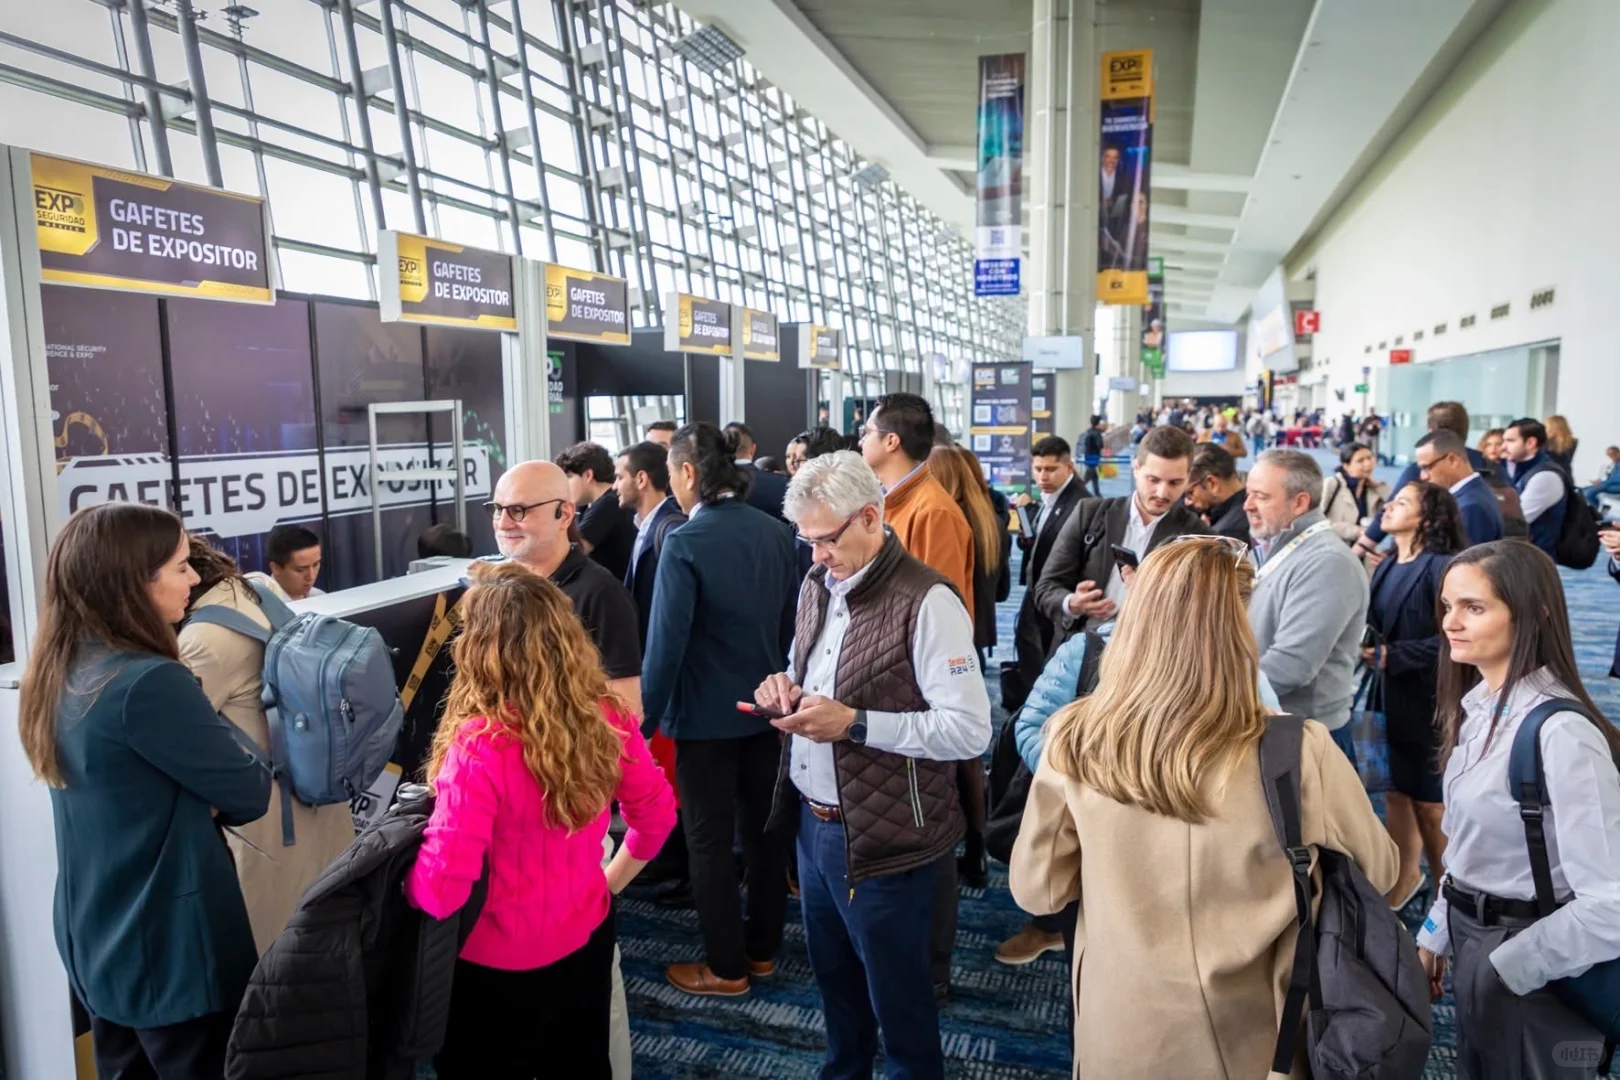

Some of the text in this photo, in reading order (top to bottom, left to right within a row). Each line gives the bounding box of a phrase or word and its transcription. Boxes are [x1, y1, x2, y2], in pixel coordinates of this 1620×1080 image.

[37, 210, 85, 226] SEGURIDAD
[110, 198, 205, 236] GAFETES
[112, 228, 258, 271] DE EXPOSITOR
[433, 261, 481, 283] GAFETES
[434, 281, 451, 299] DE
[452, 284, 509, 306] EXPOSITOR
[570, 287, 606, 306] GAFETES
[571, 304, 625, 325] DE EXPOSITOR
[277, 469, 319, 507] DE
